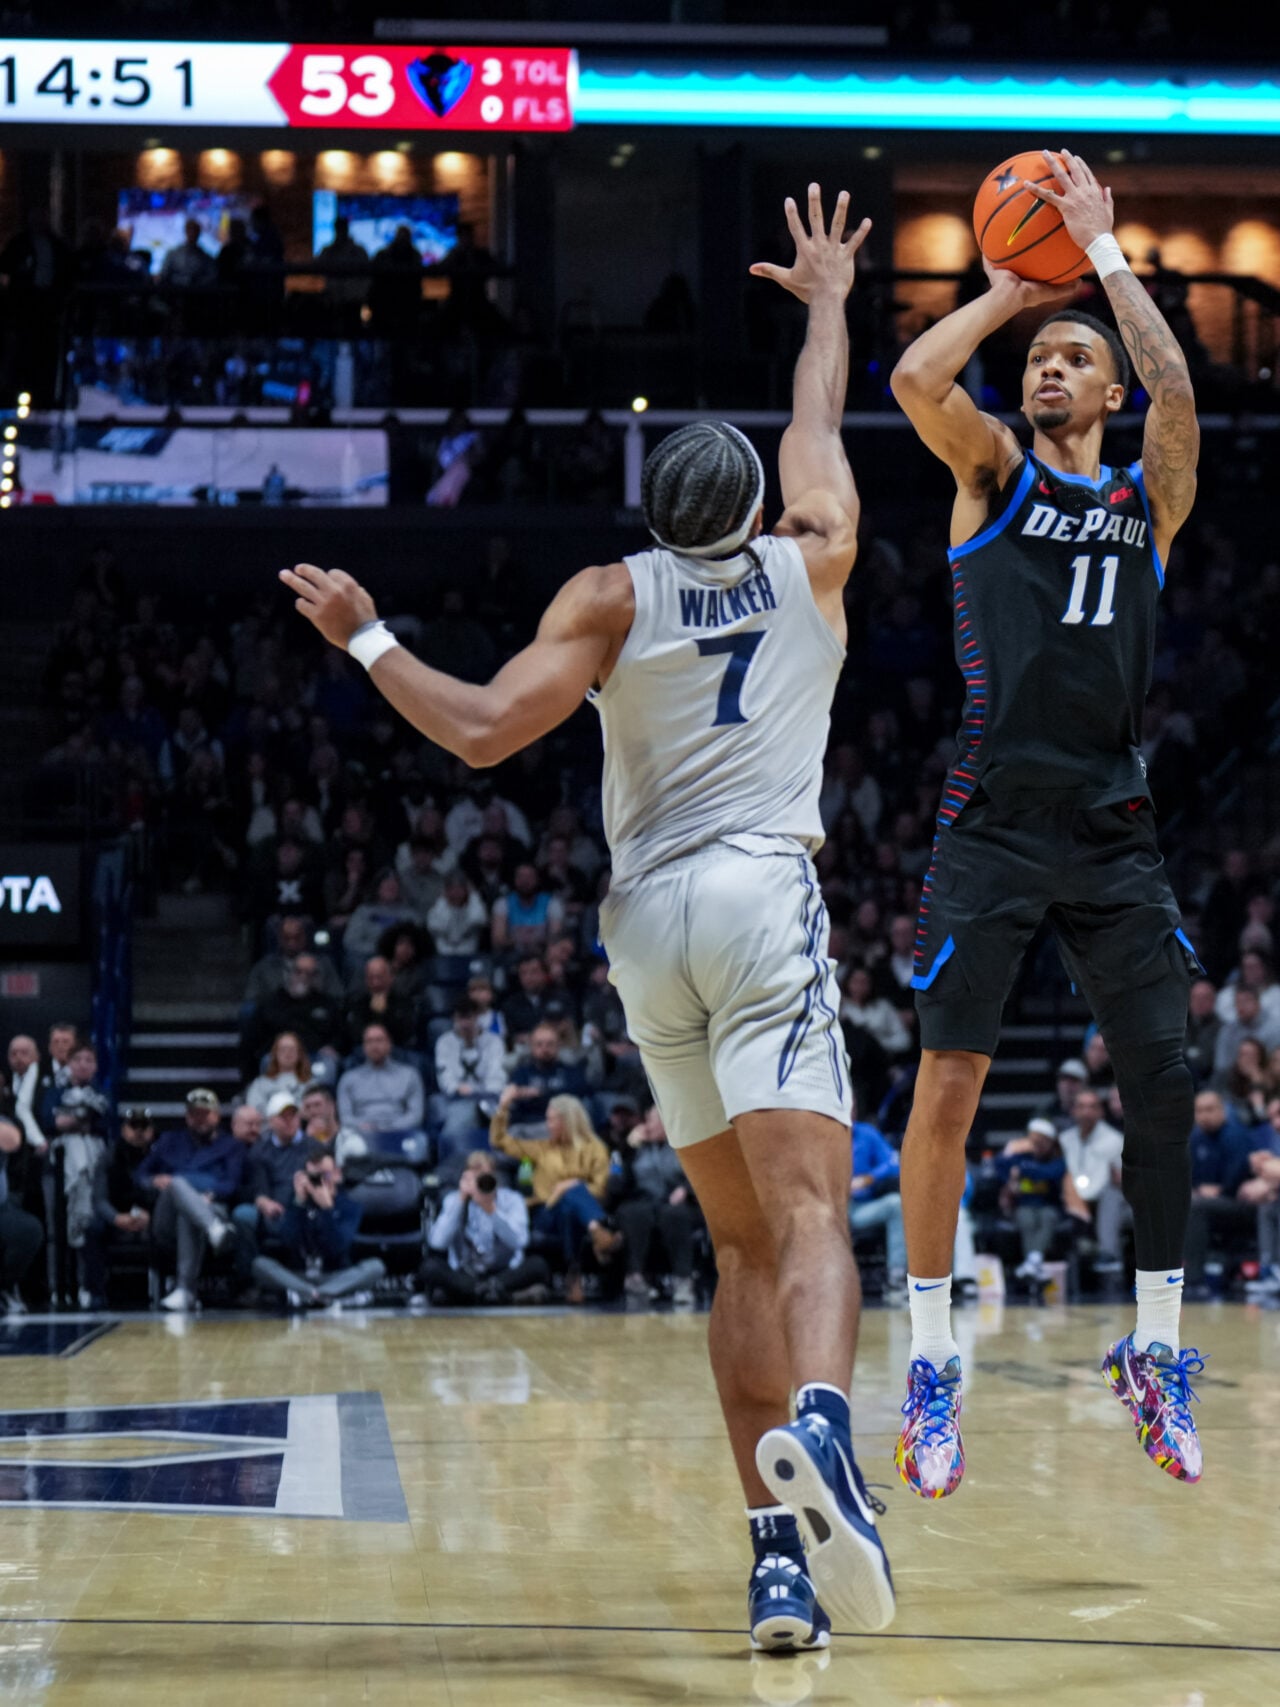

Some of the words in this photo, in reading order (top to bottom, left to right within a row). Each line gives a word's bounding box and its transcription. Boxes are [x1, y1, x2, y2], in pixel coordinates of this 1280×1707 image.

[0, 56, 193, 108] 14:51
[300, 54, 396, 117] 53
[481, 57, 503, 86] 3
[511, 59, 563, 85] TOL
[480, 95, 503, 124] 0
[511, 96, 563, 123] FLS
[678, 573, 778, 628] WALKER
[1060, 554, 1120, 626] 11
[694, 629, 768, 727] 7
[0, 875, 62, 914] TA
